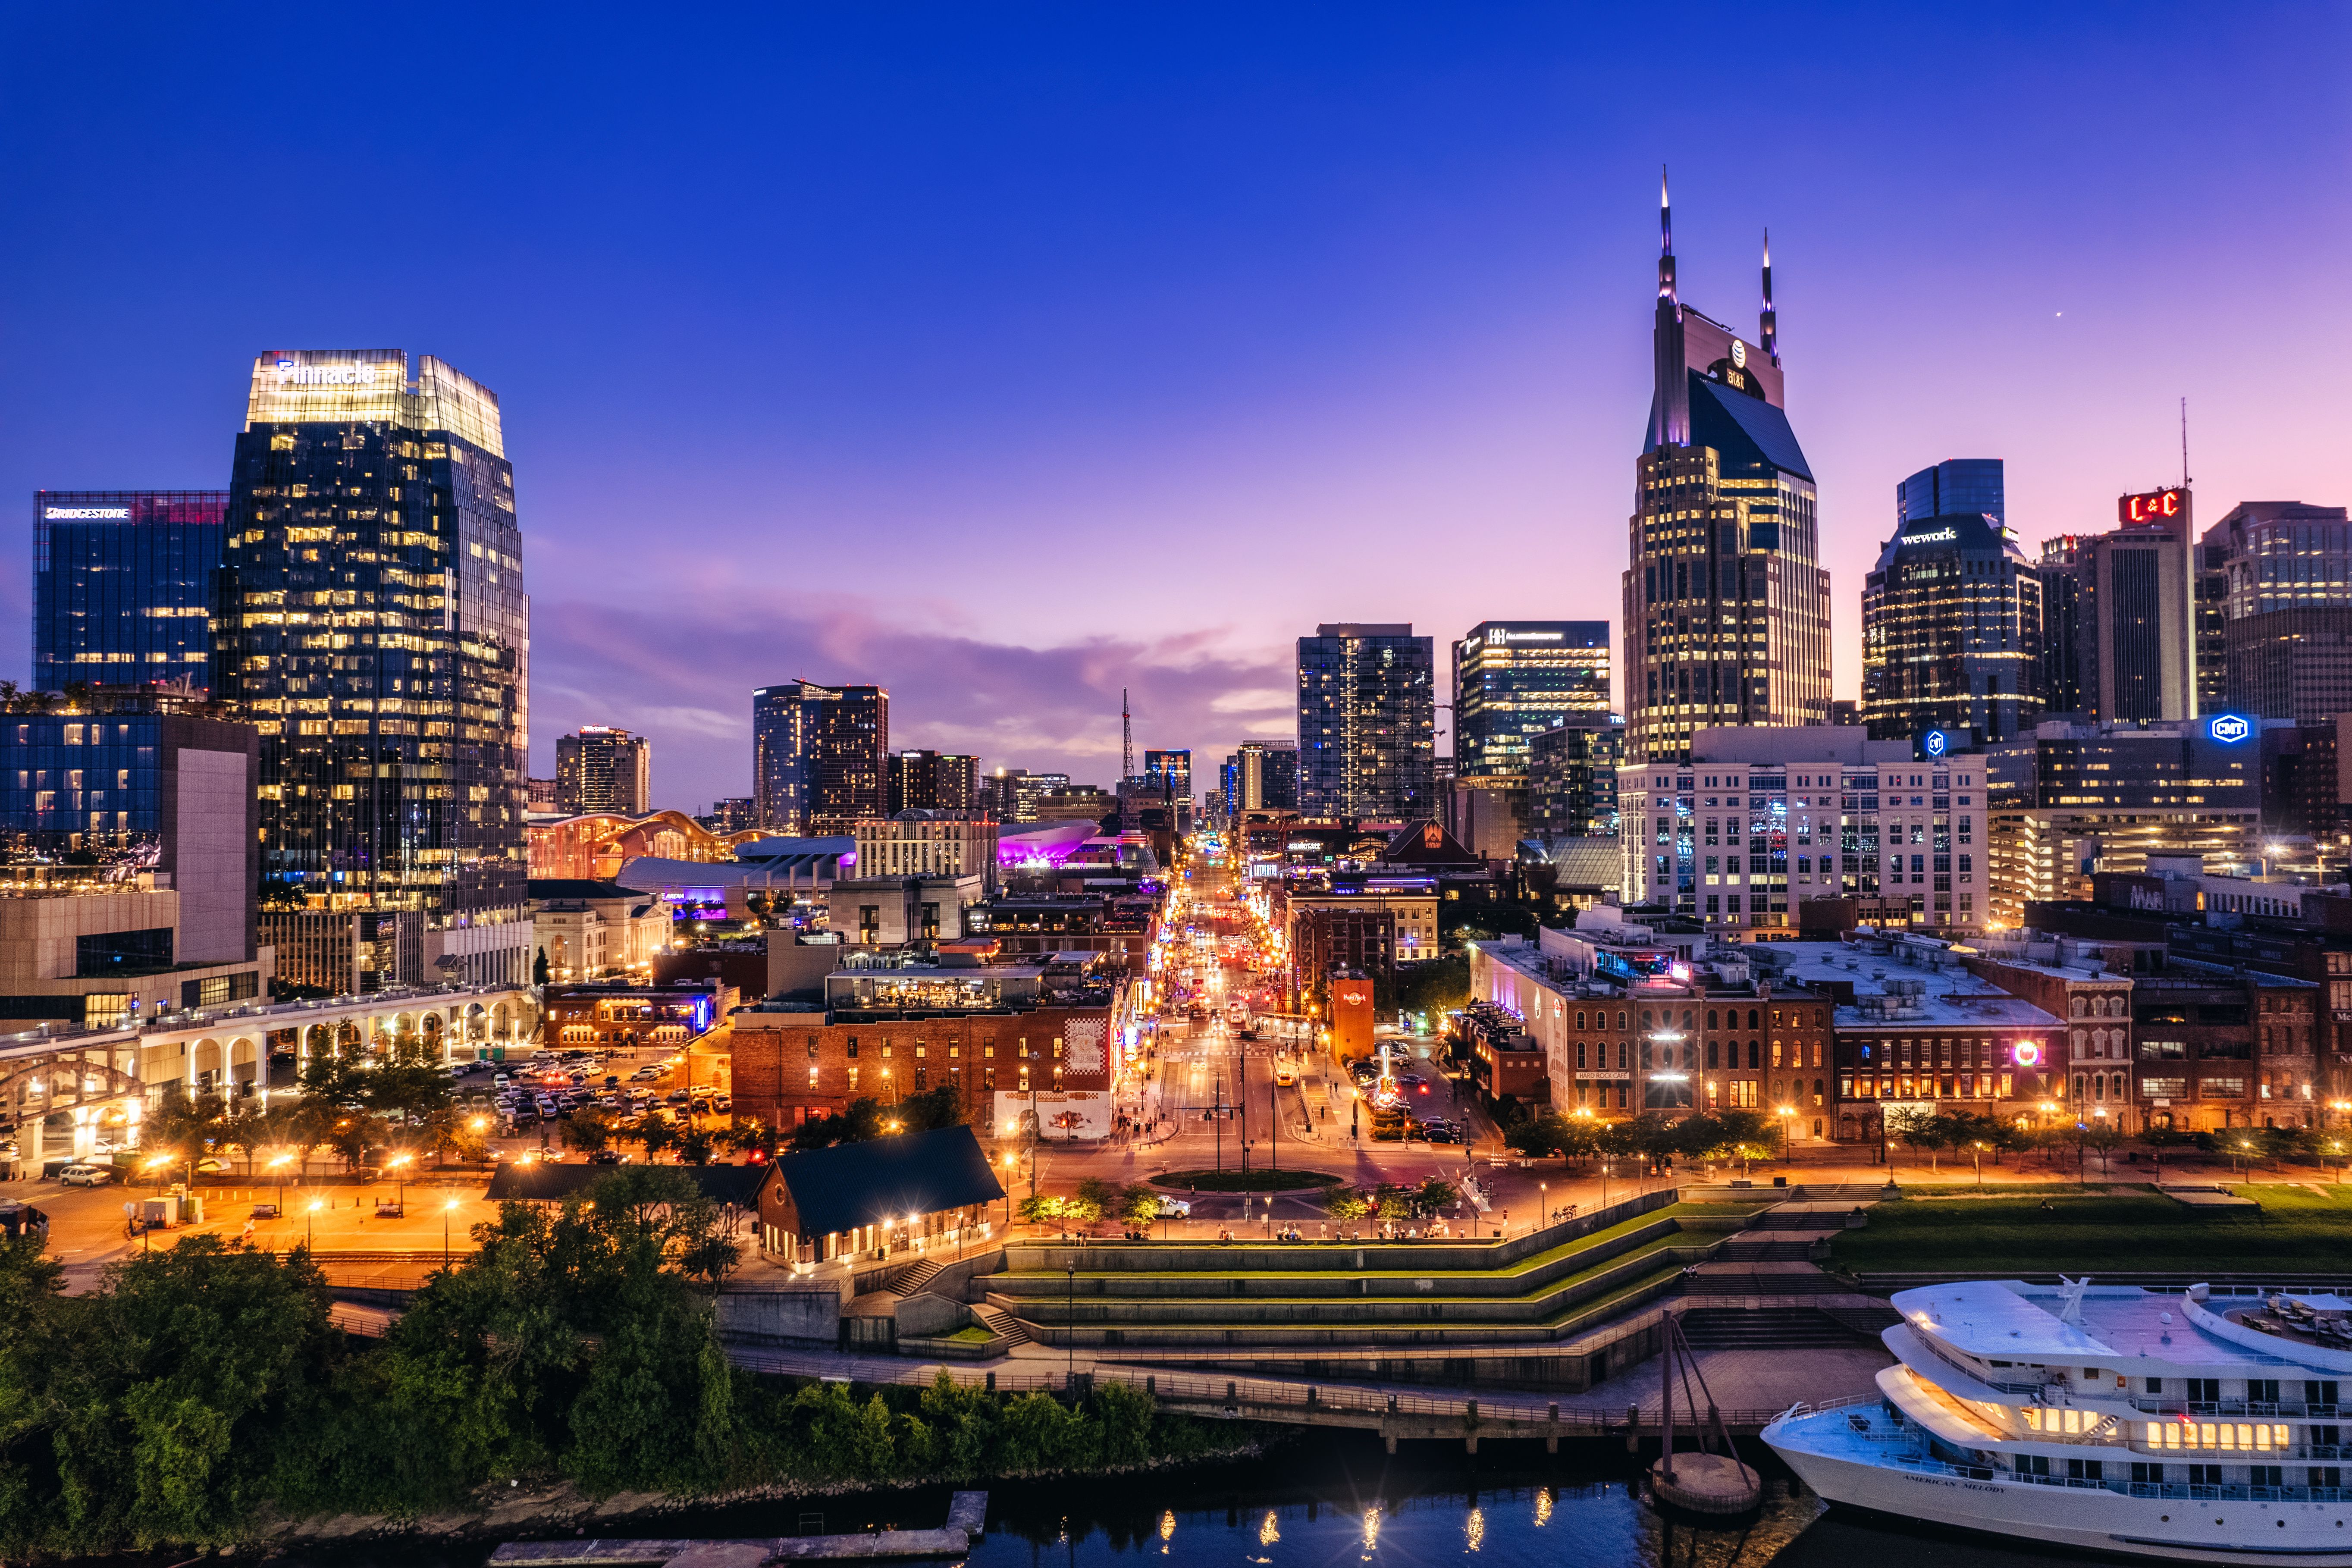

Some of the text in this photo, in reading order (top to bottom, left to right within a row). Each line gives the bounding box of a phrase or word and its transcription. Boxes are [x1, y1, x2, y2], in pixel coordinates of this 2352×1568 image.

[279, 361, 375, 384] Pinnacle
[1728, 371, 1744, 390] at&t
[45, 508, 129, 519] BRIDGESTONE
[2130, 492, 2178, 521] L & C
[1901, 527, 1957, 545] wework
[2216, 723, 2243, 734] CMT
[1071, 1025, 1099, 1038] ACME
[1904, 1475, 2004, 1493] AMERICAN MELODY
